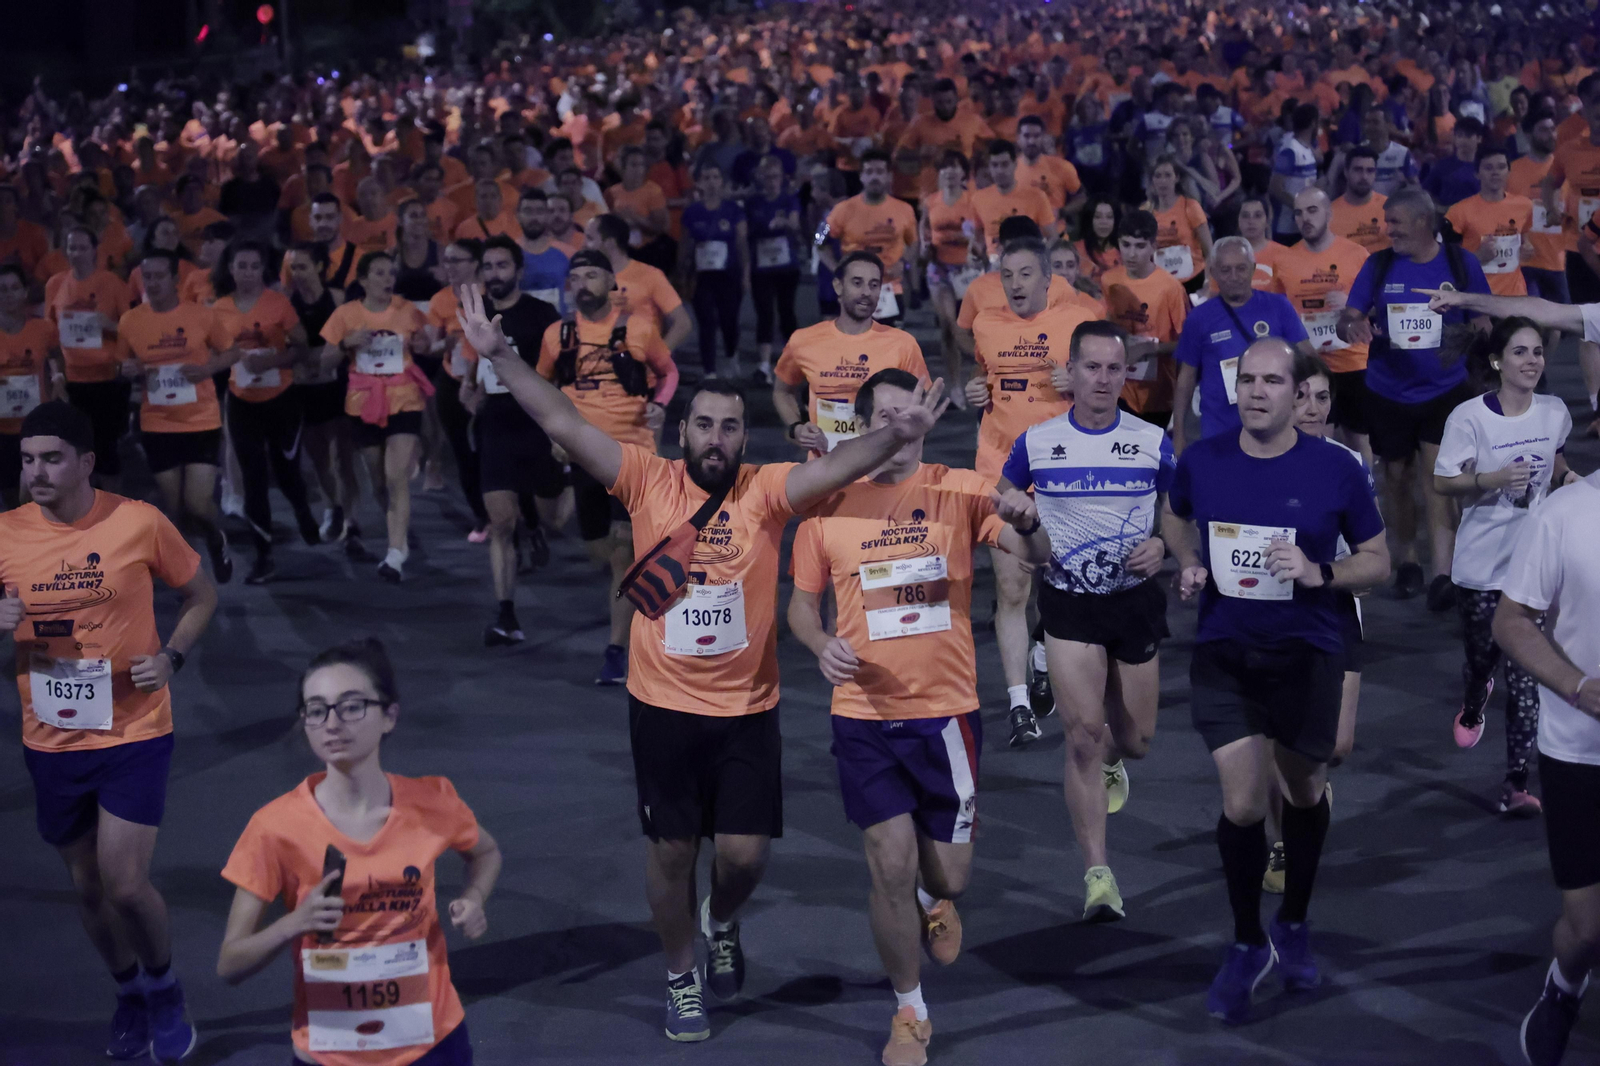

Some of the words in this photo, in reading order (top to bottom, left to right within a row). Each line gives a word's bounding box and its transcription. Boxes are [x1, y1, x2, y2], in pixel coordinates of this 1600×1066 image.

[1400, 318, 1432, 330] 17380
[834, 420, 856, 434] 204
[1110, 441, 1140, 455] ACS
[701, 527, 732, 535] CTURNA
[881, 526, 929, 537] NOCTURNA
[860, 538, 902, 550] SEVILLA
[1232, 549, 1261, 569] 622
[54, 570, 104, 582] NOCTURNA
[31, 581, 75, 592] SEVILLA
[893, 584, 926, 604] 786
[682, 608, 732, 626] 13078
[45, 680, 95, 700] 16373
[359, 888, 424, 900] NOCTURNA
[342, 981, 400, 1008] 1159
